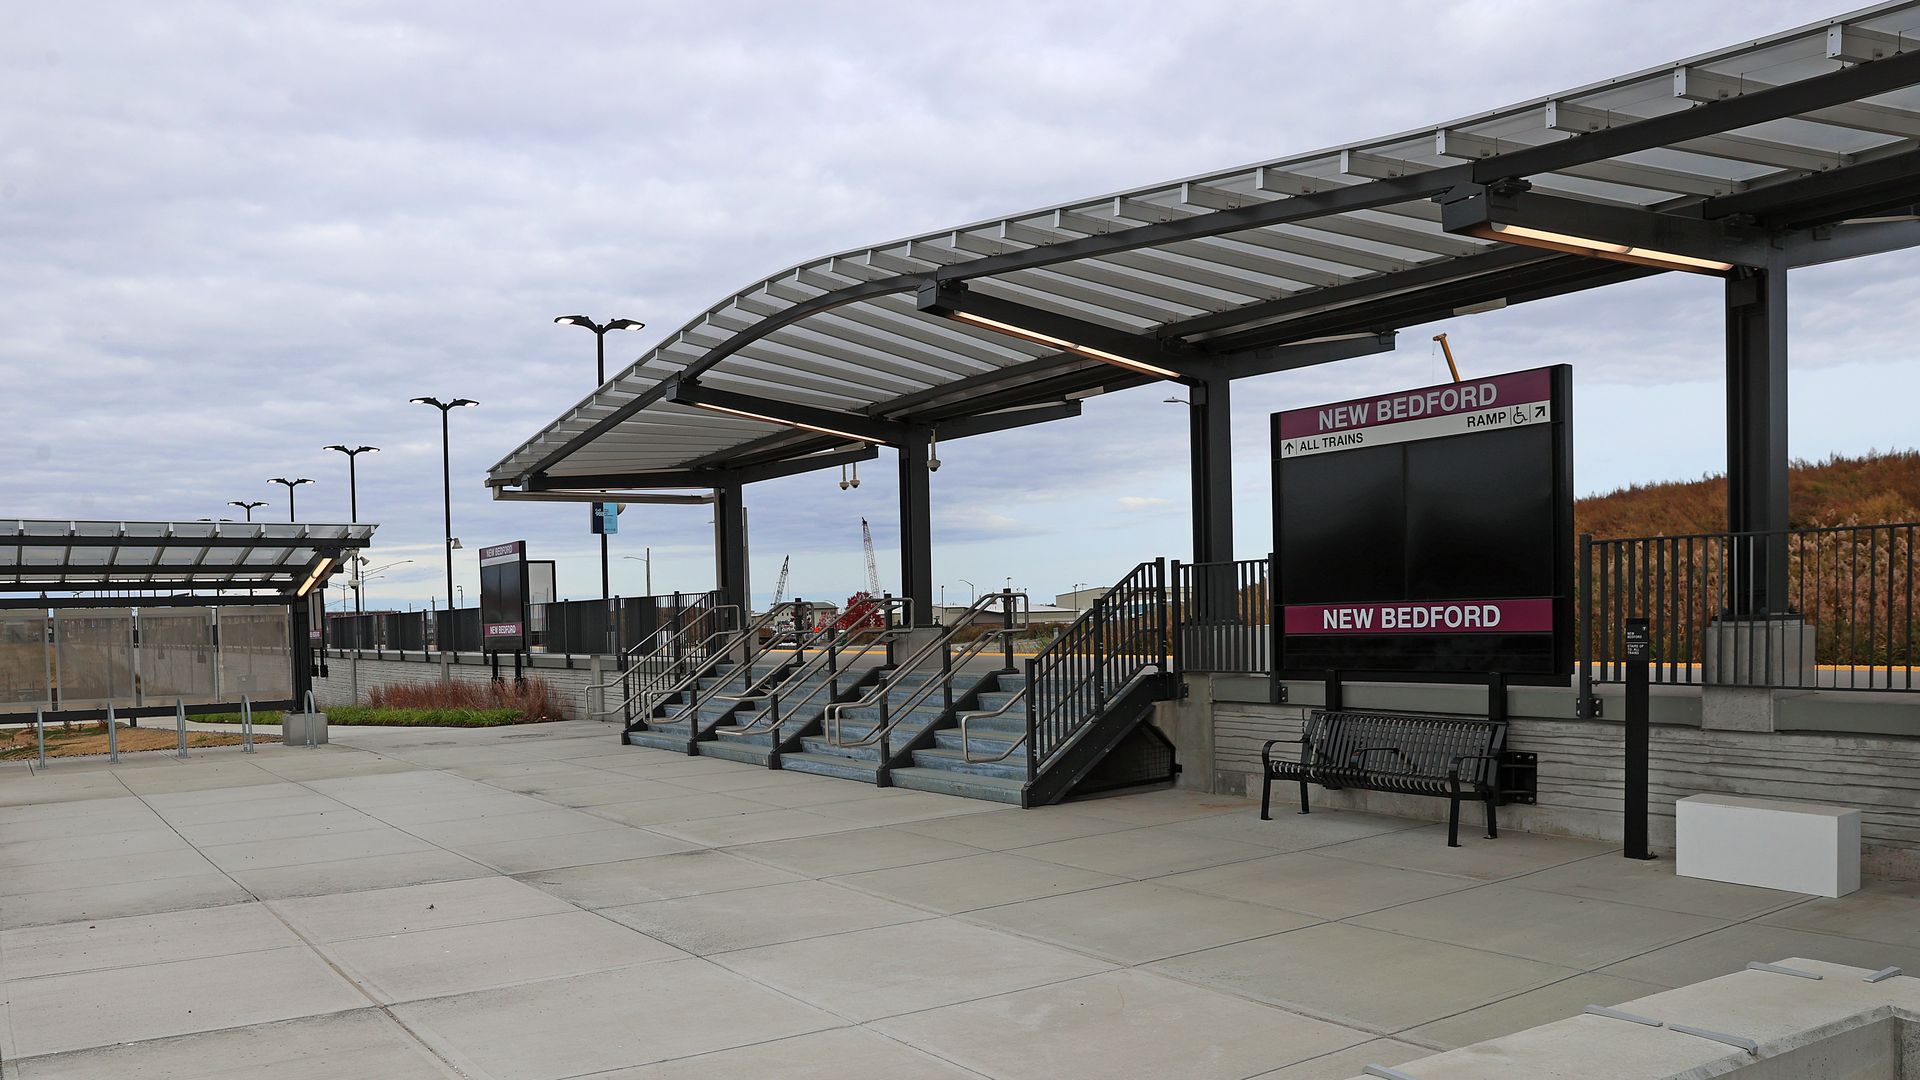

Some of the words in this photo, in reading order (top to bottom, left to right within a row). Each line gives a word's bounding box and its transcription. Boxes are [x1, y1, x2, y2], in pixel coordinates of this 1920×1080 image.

[1318, 403, 1370, 430] NEW
[1376, 383, 1497, 422] BEDFORD
[1467, 411, 1507, 428] RAMP
[1299, 440, 1320, 452] ALL
[1321, 432, 1364, 449] TRAINS
[1323, 608, 1374, 629] NEW
[1381, 605, 1501, 628] BEDFORD
[490, 625, 498, 635] NEW
[498, 624, 516, 634] BEDFORD
